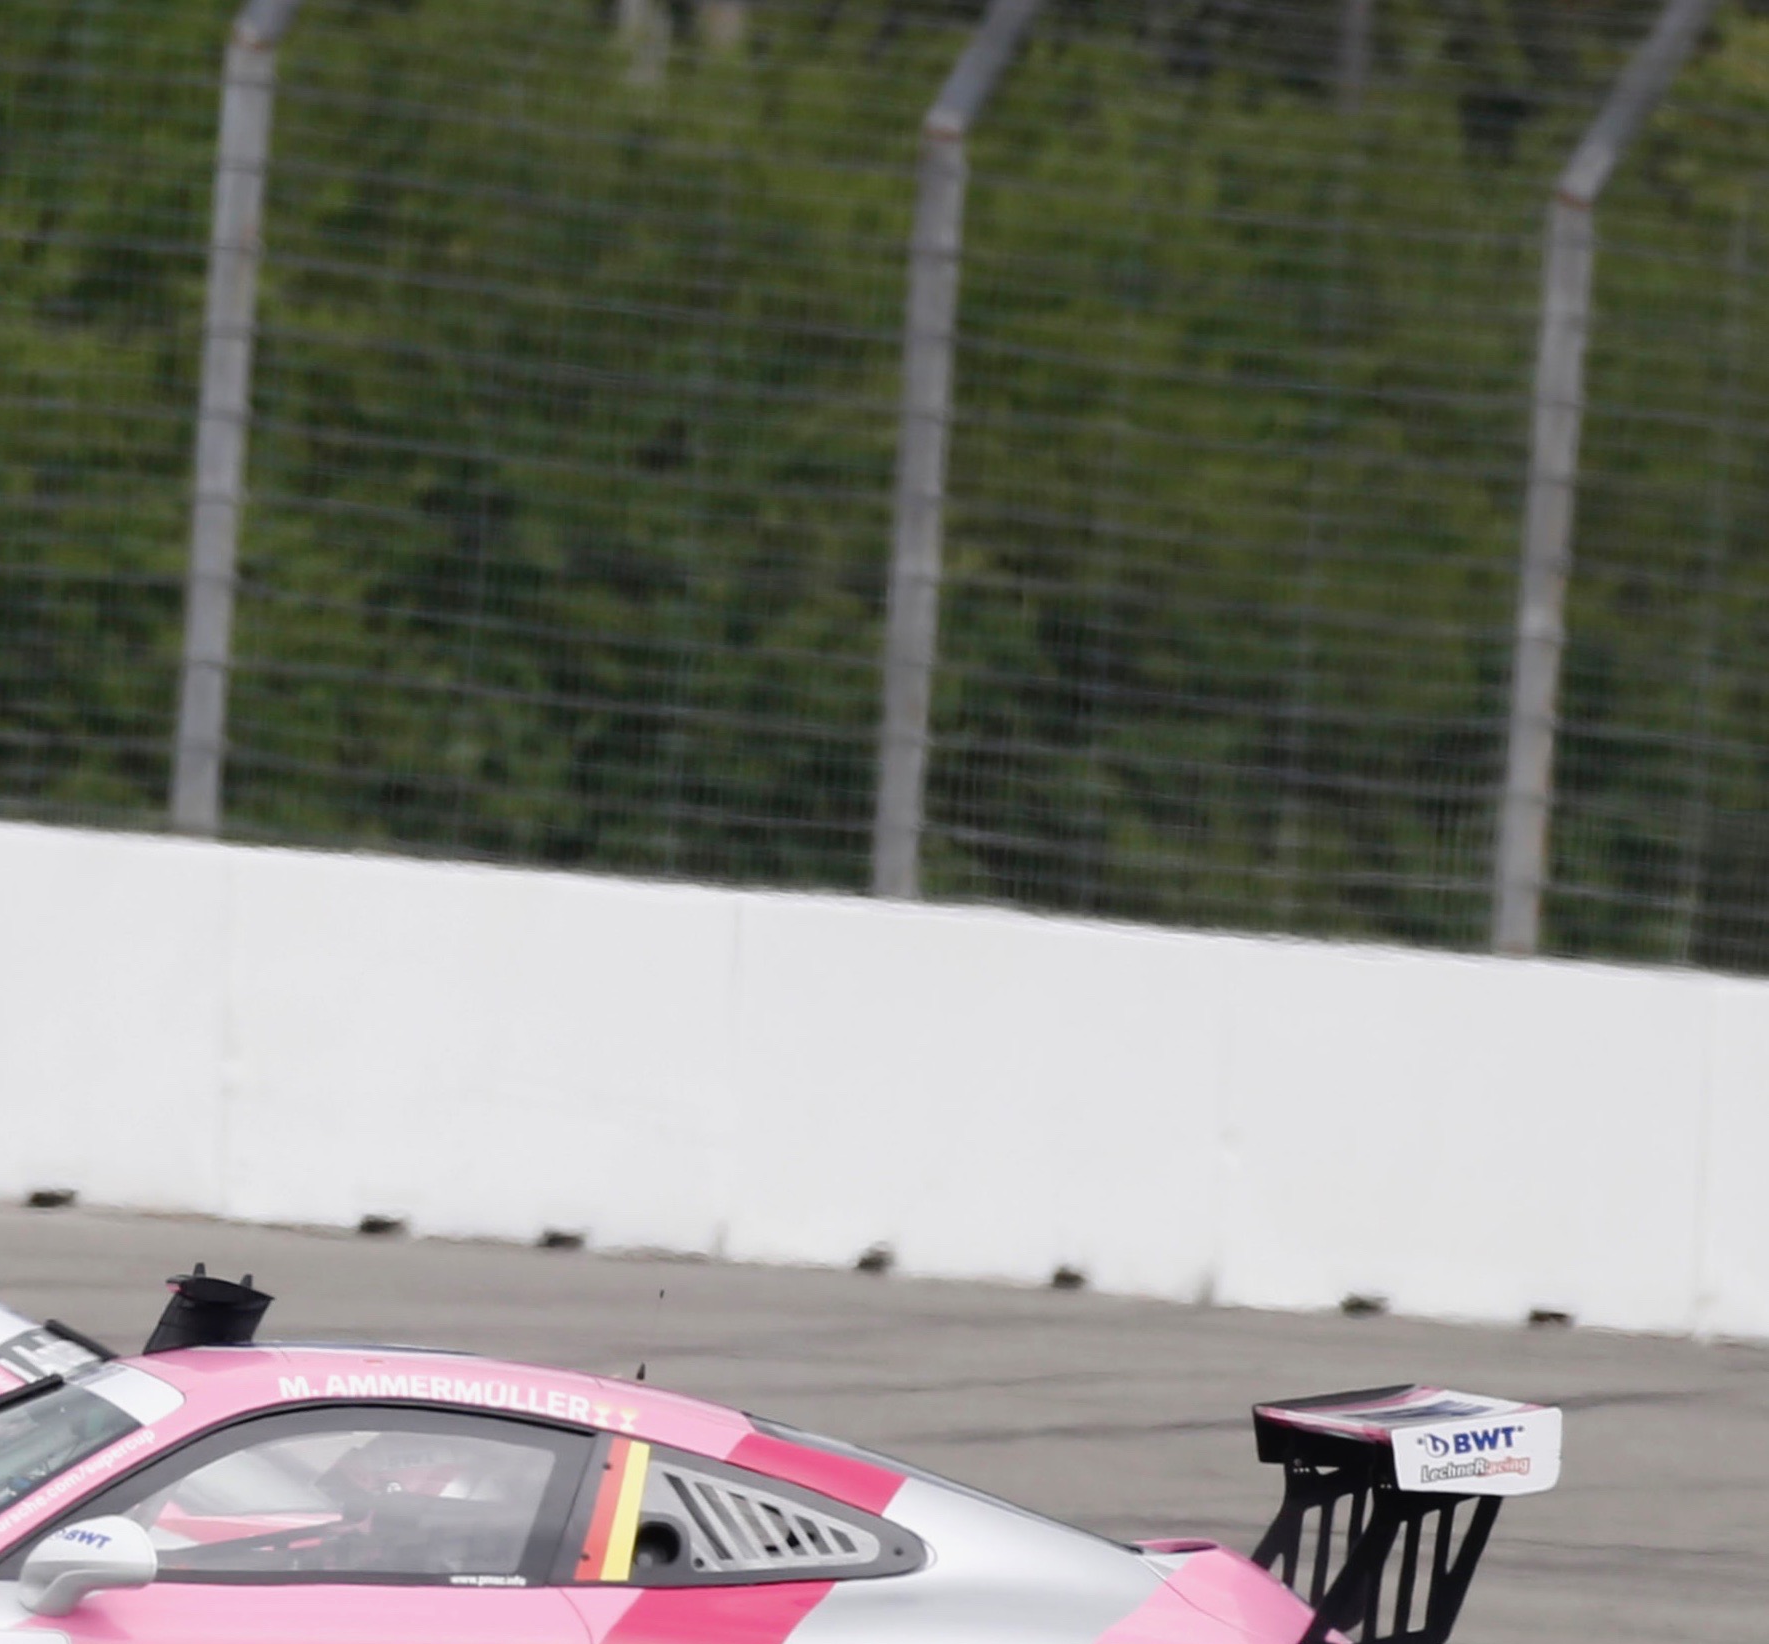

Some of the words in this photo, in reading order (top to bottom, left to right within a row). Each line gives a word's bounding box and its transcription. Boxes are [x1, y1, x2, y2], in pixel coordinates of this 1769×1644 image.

[277, 1375, 319, 1399] M.
[324, 1372, 593, 1425] AMMERMÜLLER
[1453, 1425, 1515, 1455] BWT
